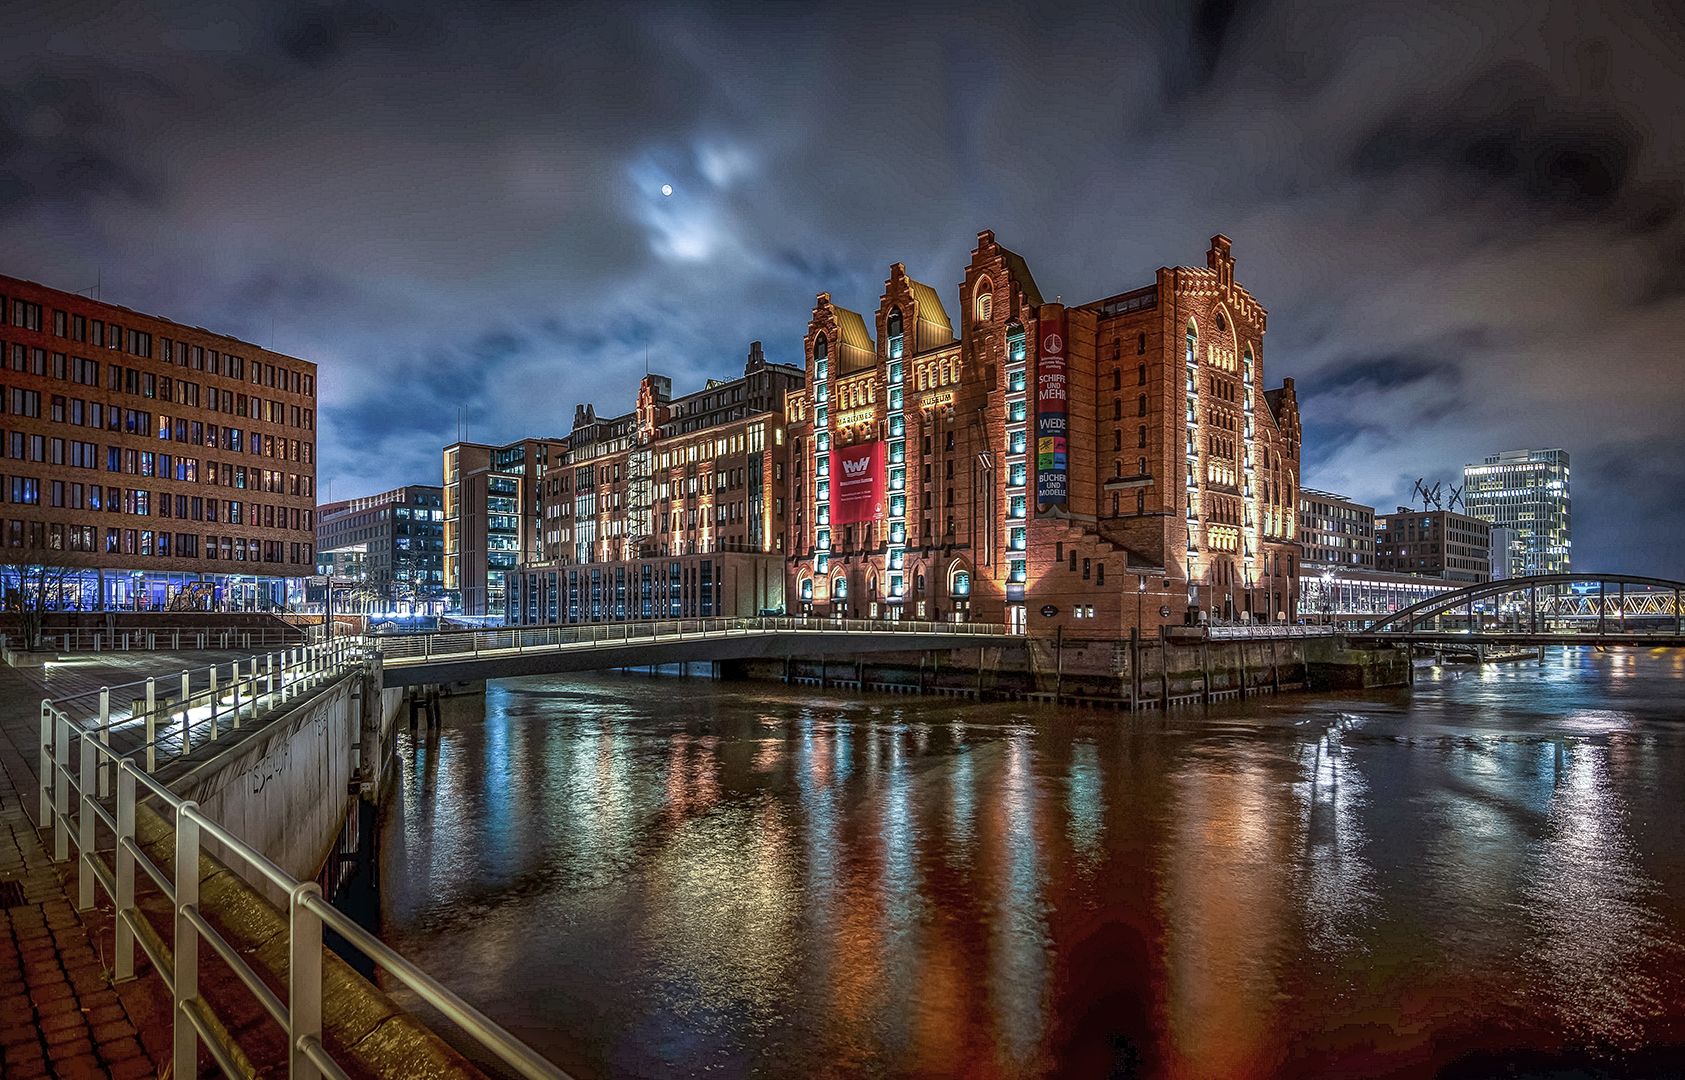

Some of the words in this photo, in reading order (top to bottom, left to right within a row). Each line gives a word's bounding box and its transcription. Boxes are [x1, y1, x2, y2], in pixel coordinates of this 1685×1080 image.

[1039, 374, 1066, 384] SCHIFFE
[1046, 382, 1061, 390] UND
[1039, 389, 1066, 400] MEHR
[1039, 418, 1066, 430] WEDE
[1039, 489, 1066, 497] MODELLE
